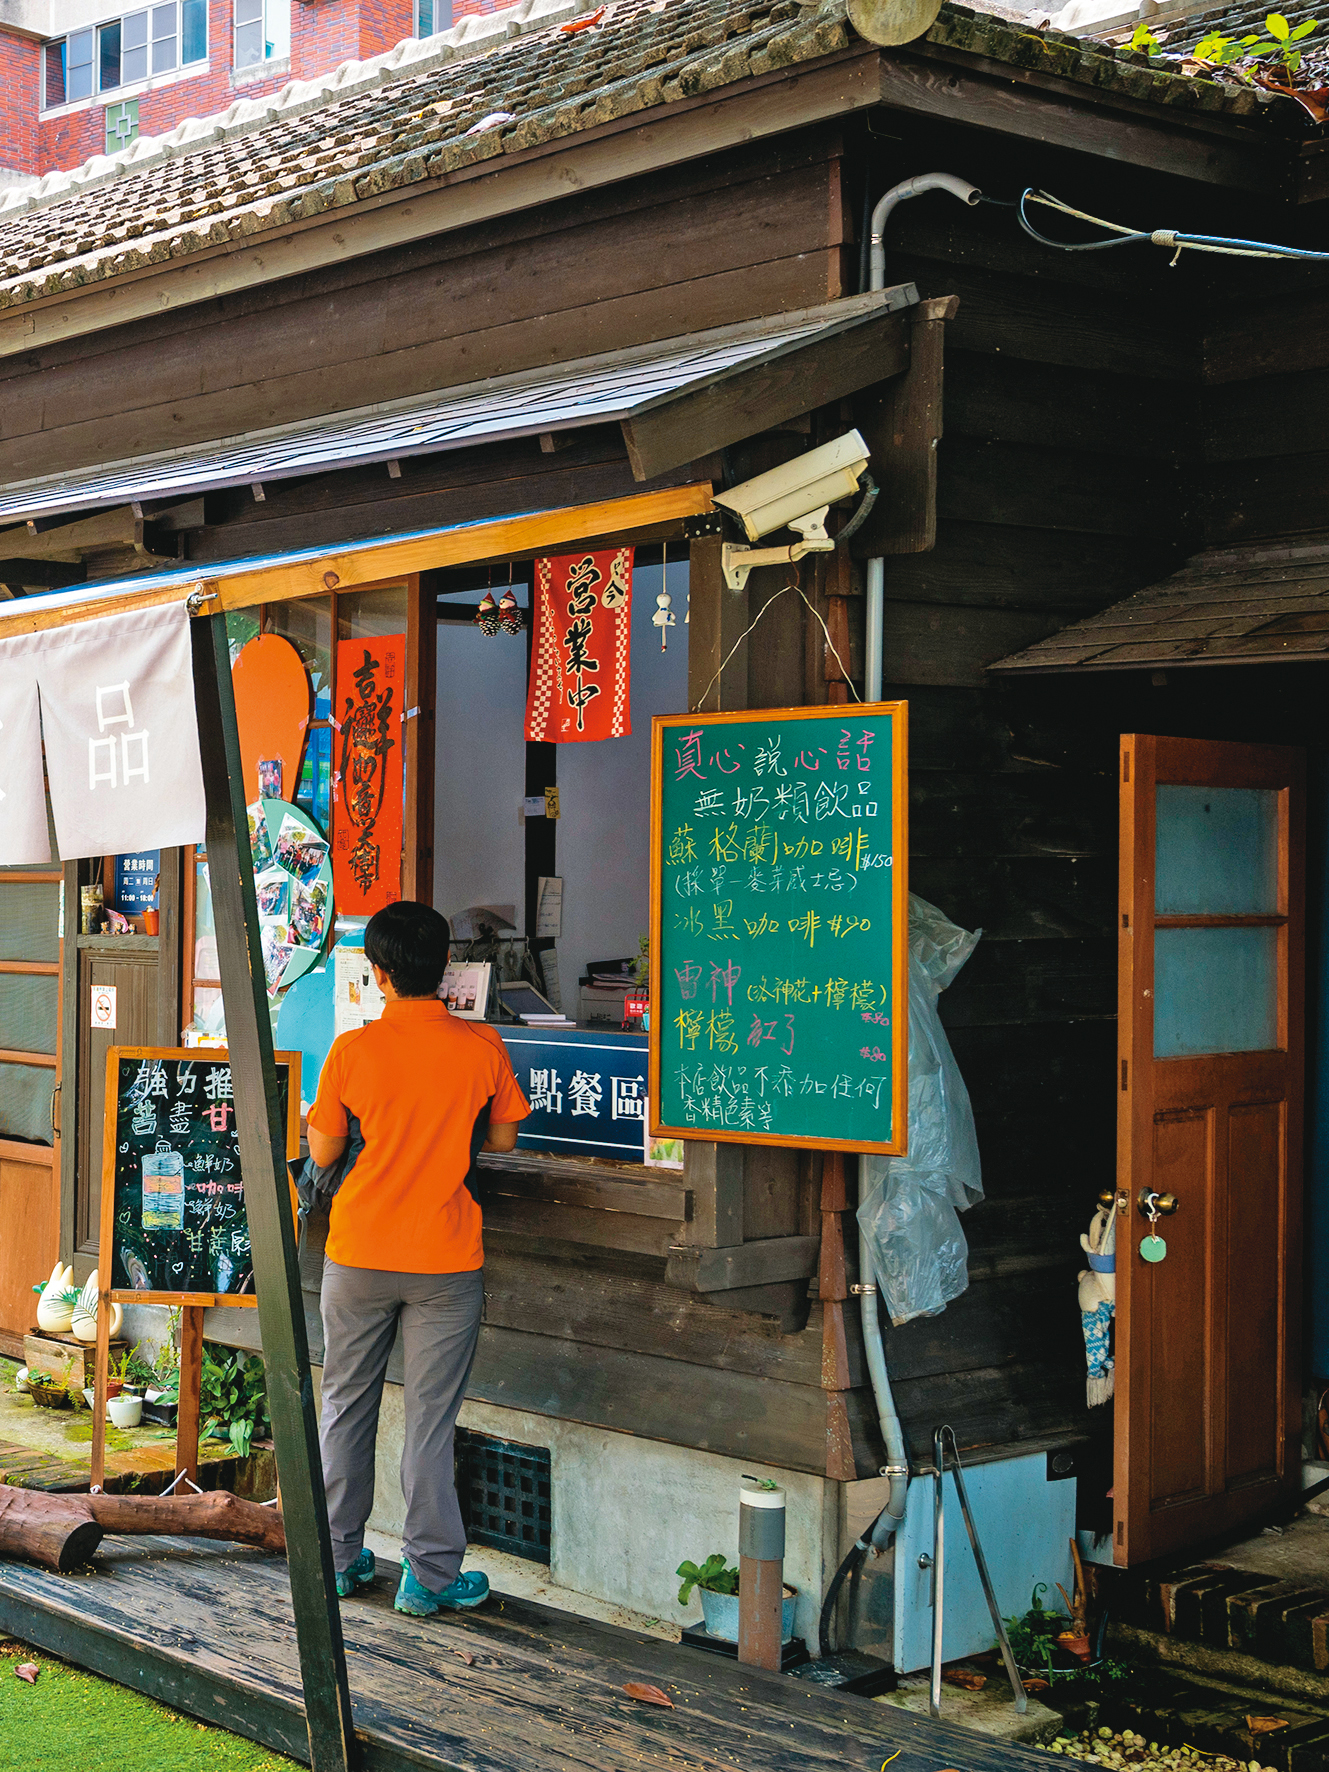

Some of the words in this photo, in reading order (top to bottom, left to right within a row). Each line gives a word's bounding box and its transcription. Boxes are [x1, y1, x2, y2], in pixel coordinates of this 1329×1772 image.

[693, 781, 878, 824] 無奶類飲品
[529, 1068, 645, 1120] 點餐區
